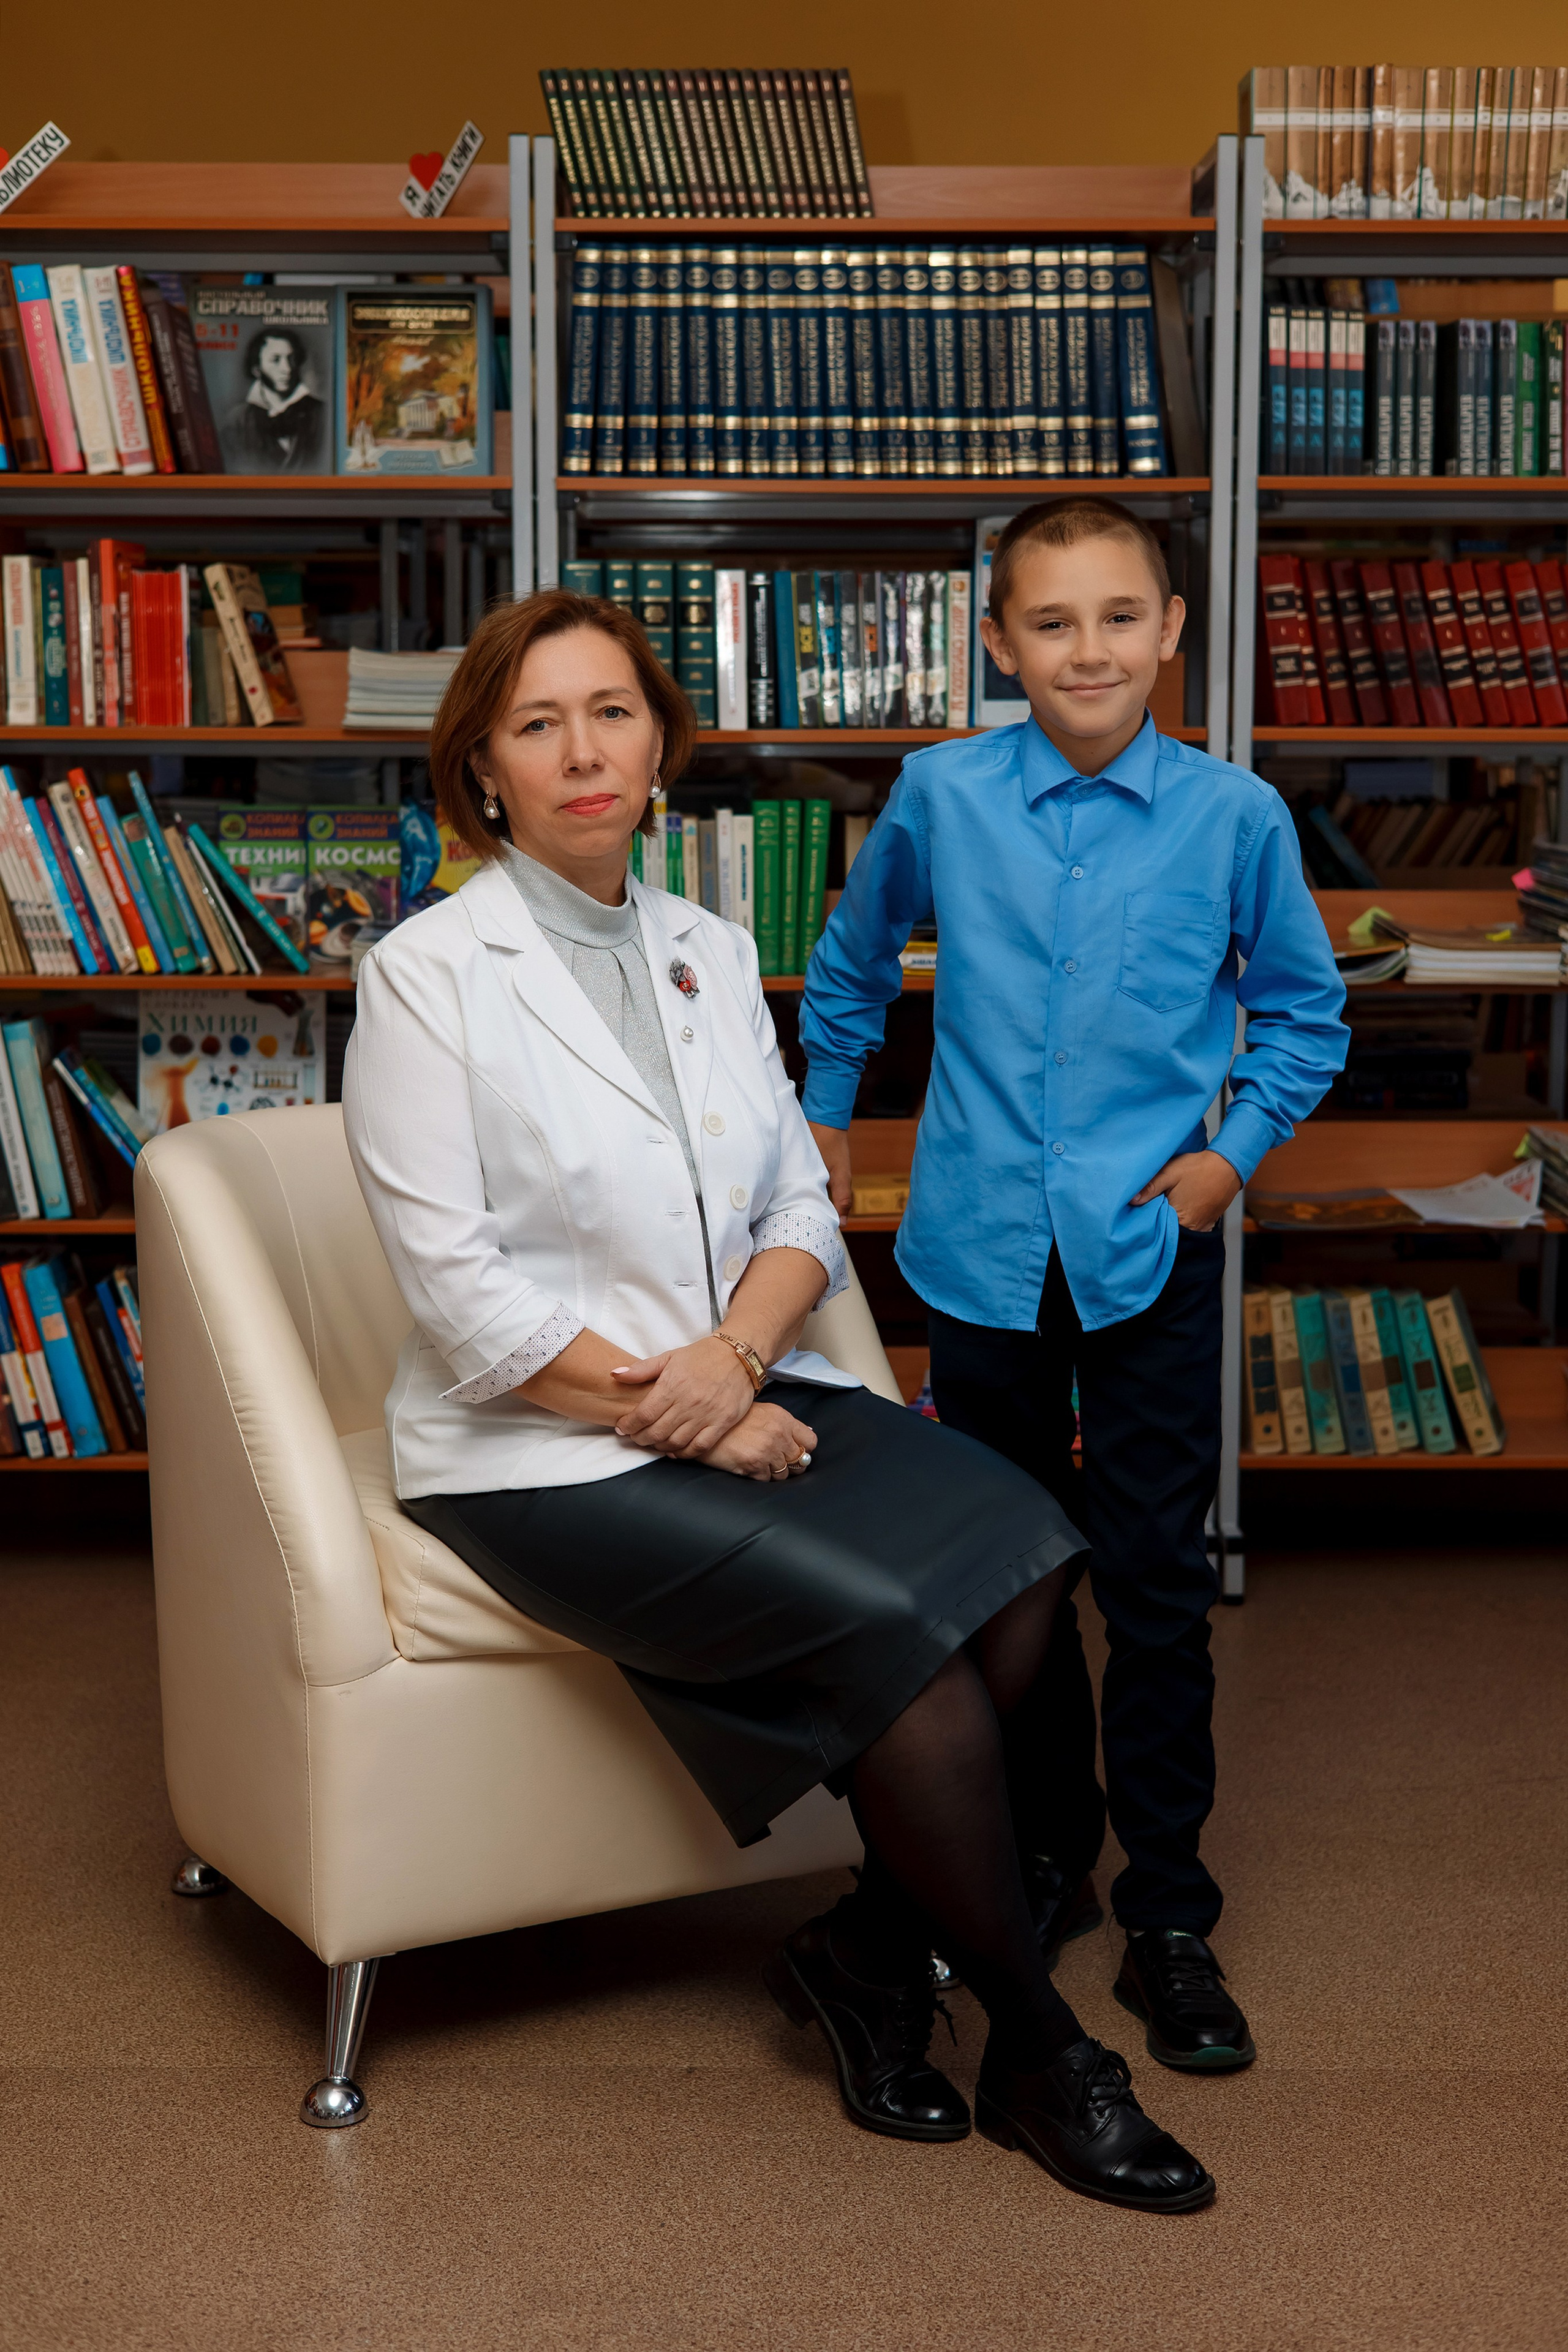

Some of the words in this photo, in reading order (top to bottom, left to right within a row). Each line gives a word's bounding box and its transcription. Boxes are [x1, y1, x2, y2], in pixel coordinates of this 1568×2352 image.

[0, 127, 64, 206] БЛИОТЕКУ
[405, 186, 421, 207] Я
[198, 300, 328, 315] СПРАВОЧНИК
[121, 275, 157, 405] ШКОЛЬНИКА
[573, 429, 582, 442] 1
[605, 430, 614, 444] 2
[696, 429, 705, 443] 5
[724, 430, 734, 445] 6
[750, 431, 760, 445] 7
[832, 431, 848, 445] 10
[914, 431, 929, 445] 13
[941, 432, 957, 446] 14
[968, 431, 983, 446] 15
[1017, 430, 1034, 444] 17
[1044, 431, 1060, 446] 18
[1073, 431, 1088, 445] 19
[148, 1011, 257, 1033] ХИМИЯ
